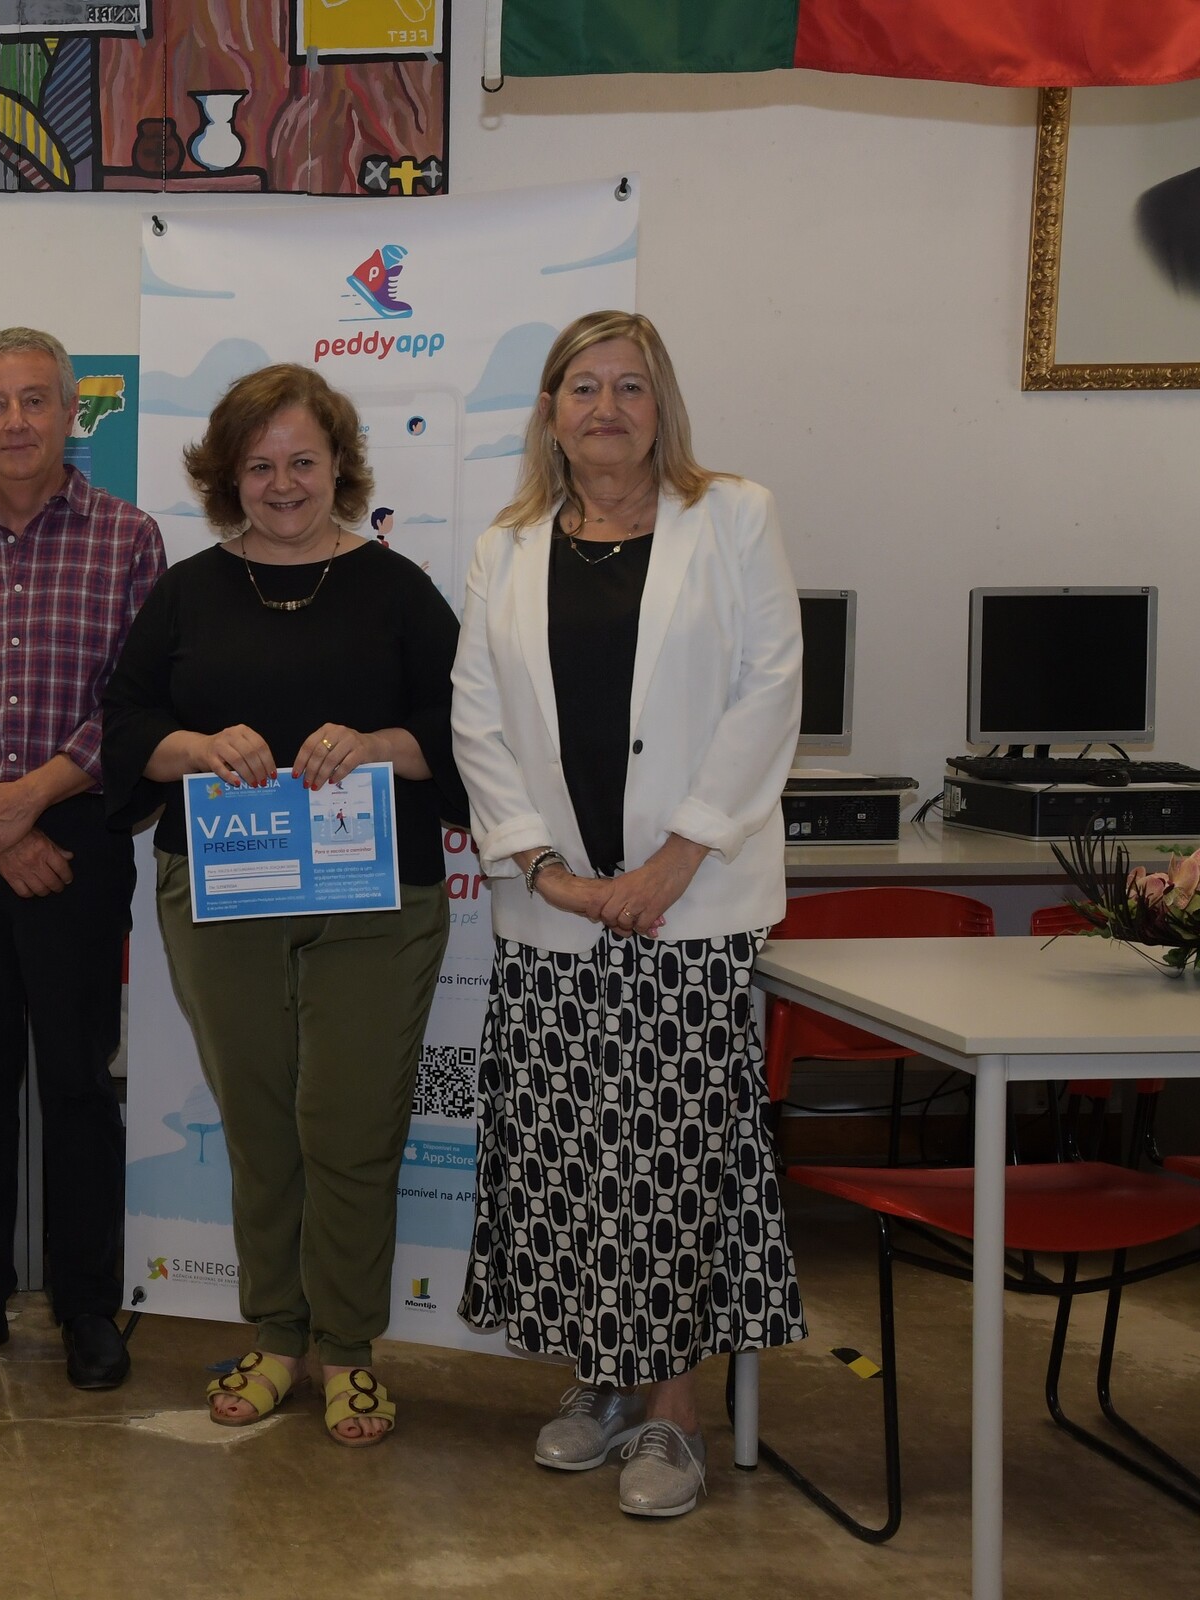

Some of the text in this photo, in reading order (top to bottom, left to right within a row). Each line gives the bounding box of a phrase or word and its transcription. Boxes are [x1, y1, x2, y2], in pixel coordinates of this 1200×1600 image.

[314, 330, 445, 363] peddyapp
[196, 811, 292, 839] VALE
[204, 838, 289, 854] PRESENTE
[461, 910, 479, 927] pé
[436, 974, 453, 985] os
[422, 1152, 474, 1166] App Store
[440, 1192, 453, 1201] na
[405, 1299, 437, 1310] Montijo
